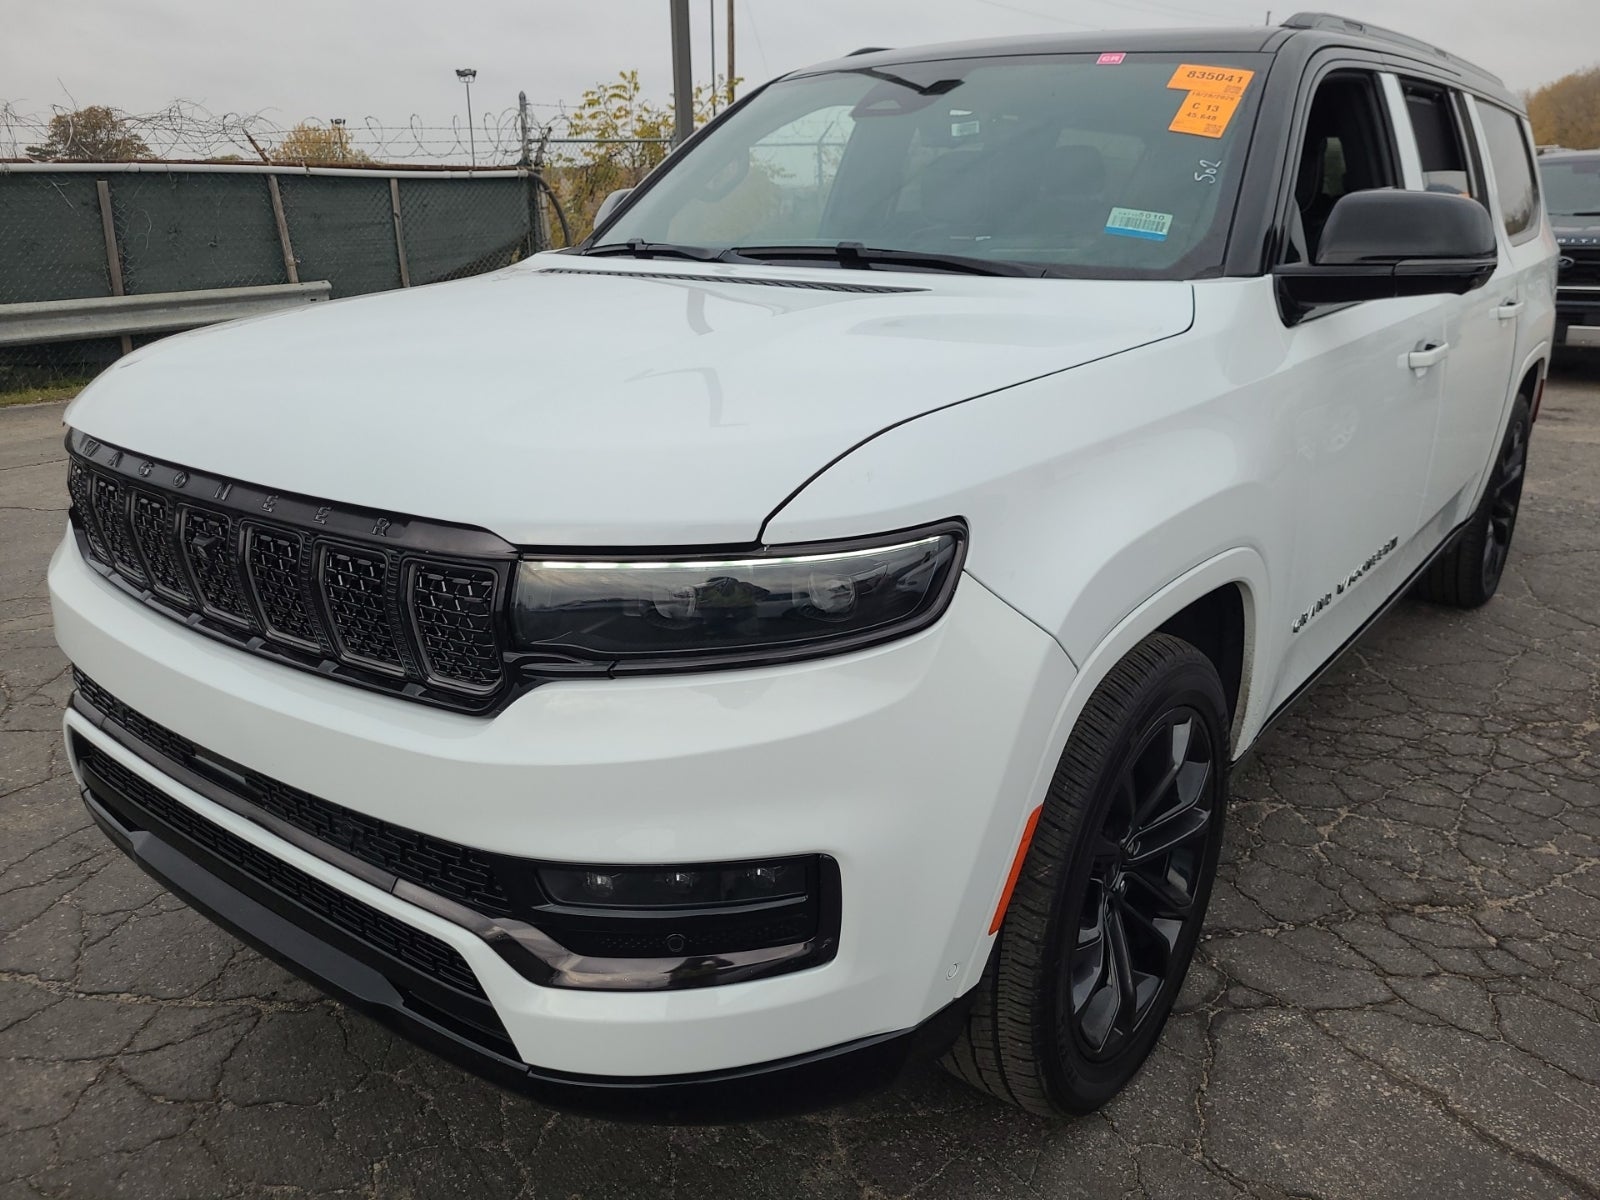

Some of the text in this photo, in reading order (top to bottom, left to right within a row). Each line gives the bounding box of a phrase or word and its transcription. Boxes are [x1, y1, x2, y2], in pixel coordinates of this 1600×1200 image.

[1187, 70, 1243, 83] 835041
[1192, 102, 1220, 113] C 13
[83, 439, 391, 537] WAGONEER
